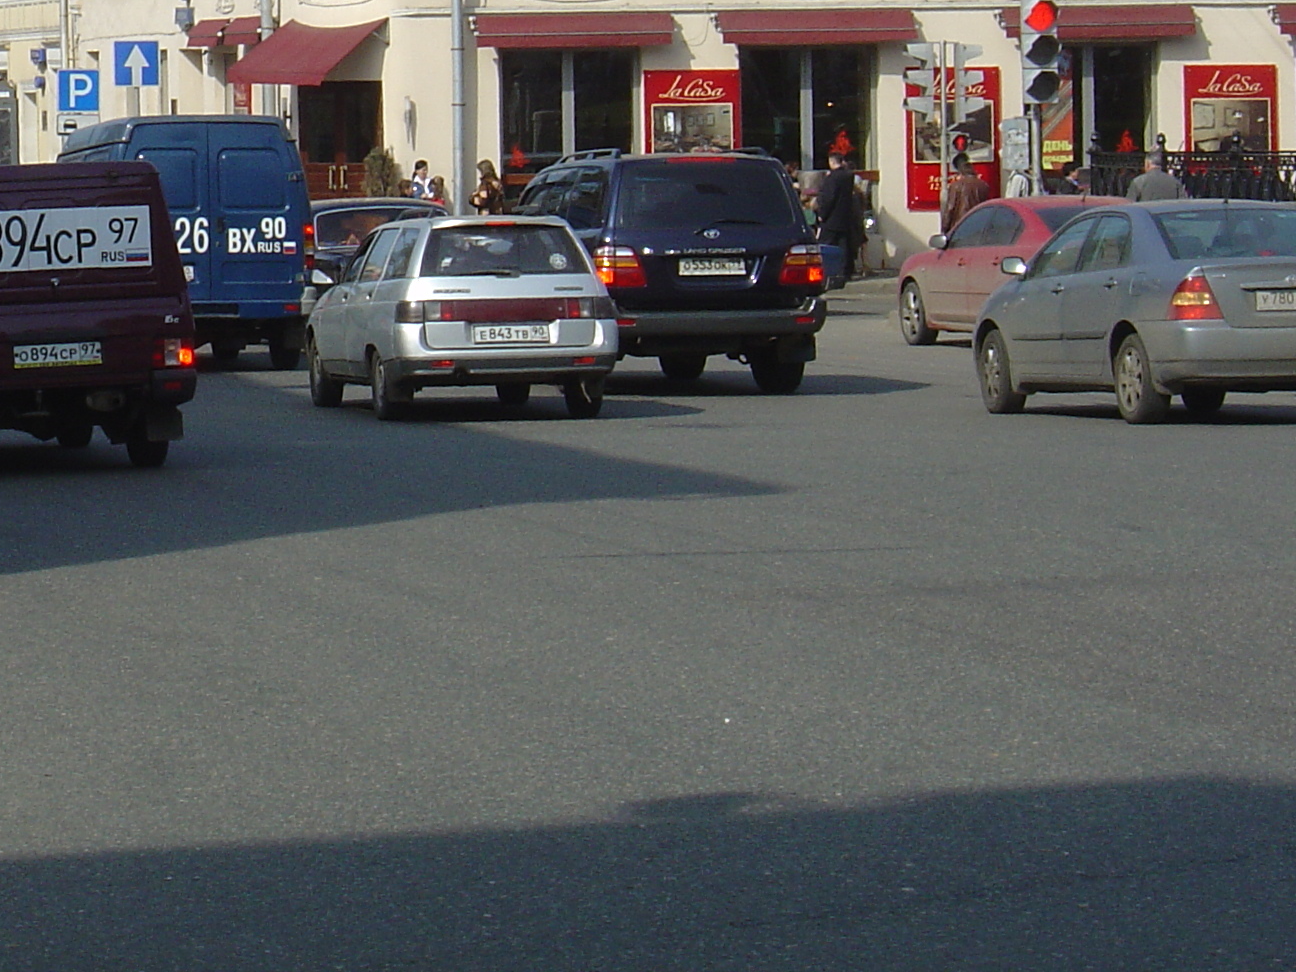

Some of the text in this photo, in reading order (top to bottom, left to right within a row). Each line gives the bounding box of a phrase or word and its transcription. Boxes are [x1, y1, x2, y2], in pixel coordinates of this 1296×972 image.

[658, 75, 682, 98] La
[1198, 71, 1221, 93] La
[1042, 141, 1073, 153] ДЕНЬ
[108, 217, 138, 244] 97
[261, 217, 286, 239] 90
[101, 251, 125, 262] RUS
[257, 241, 281, 253] RUS
